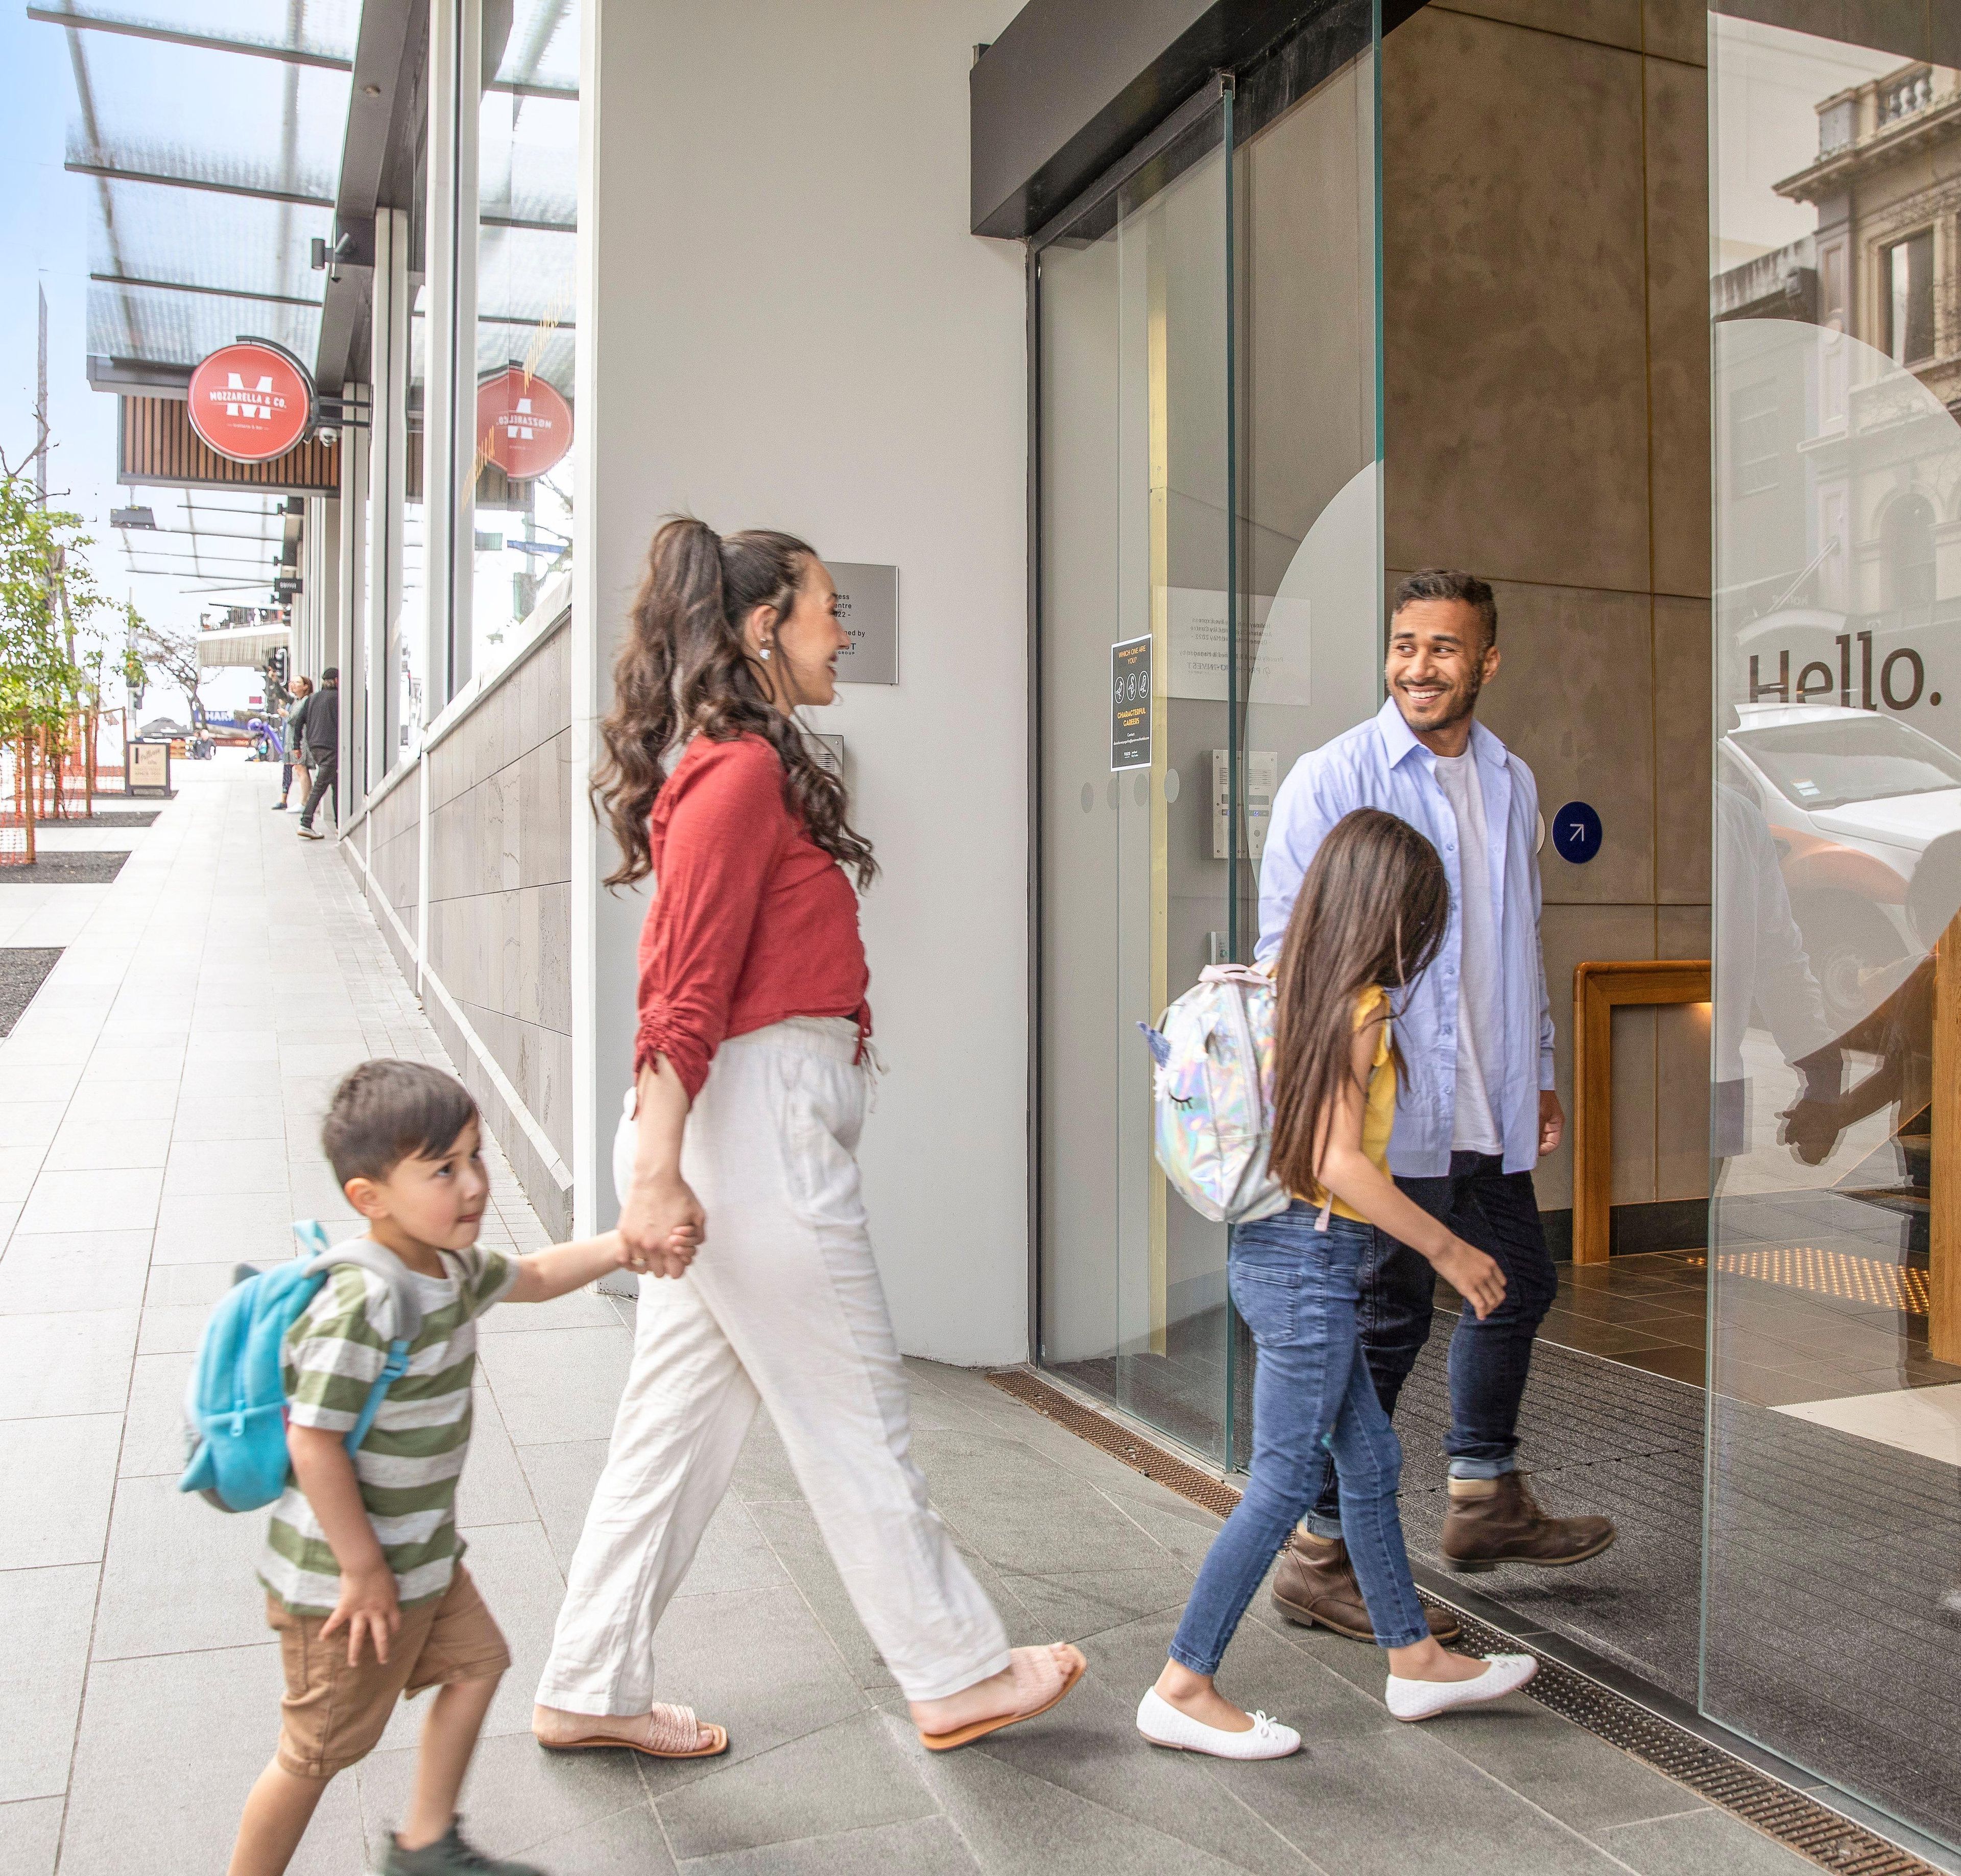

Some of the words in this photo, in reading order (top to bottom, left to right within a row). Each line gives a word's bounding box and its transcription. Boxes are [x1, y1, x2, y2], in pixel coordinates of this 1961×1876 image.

[209, 391, 262, 403] MOZZARELLA
[265, 396, 271, 405] &
[273, 397, 287, 409] CO.
[1118, 649, 1131, 658] WHICH
[1127, 656, 1137, 664] YOU?
[1749, 630, 1943, 711] Hello.
[1117, 707, 1146, 719] CHARACTERFUL
[1123, 717, 1140, 727] CAREERS
